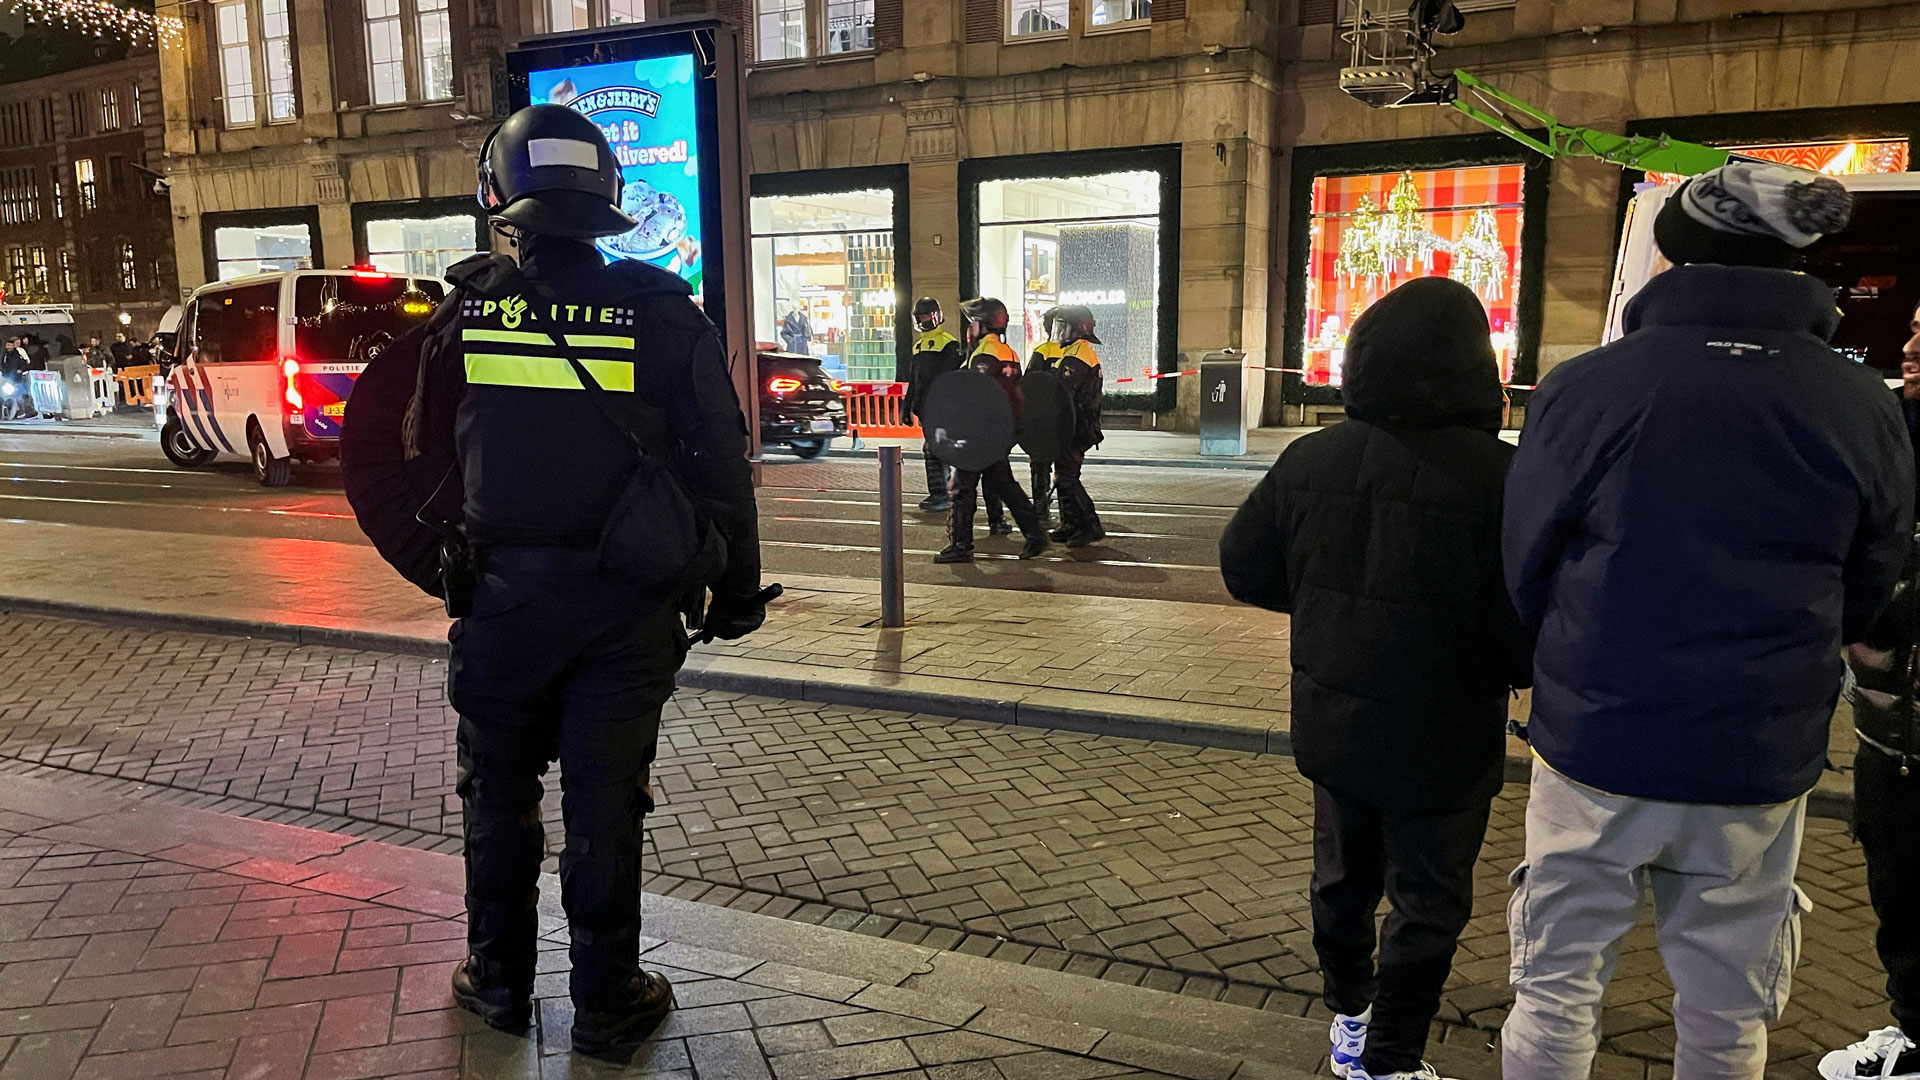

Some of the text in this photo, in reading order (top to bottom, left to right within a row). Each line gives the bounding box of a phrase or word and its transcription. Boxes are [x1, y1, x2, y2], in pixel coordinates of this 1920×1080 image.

[598, 120, 639, 142] et it
[616, 140, 688, 167] livered!
[482, 294, 614, 328] POITIE
